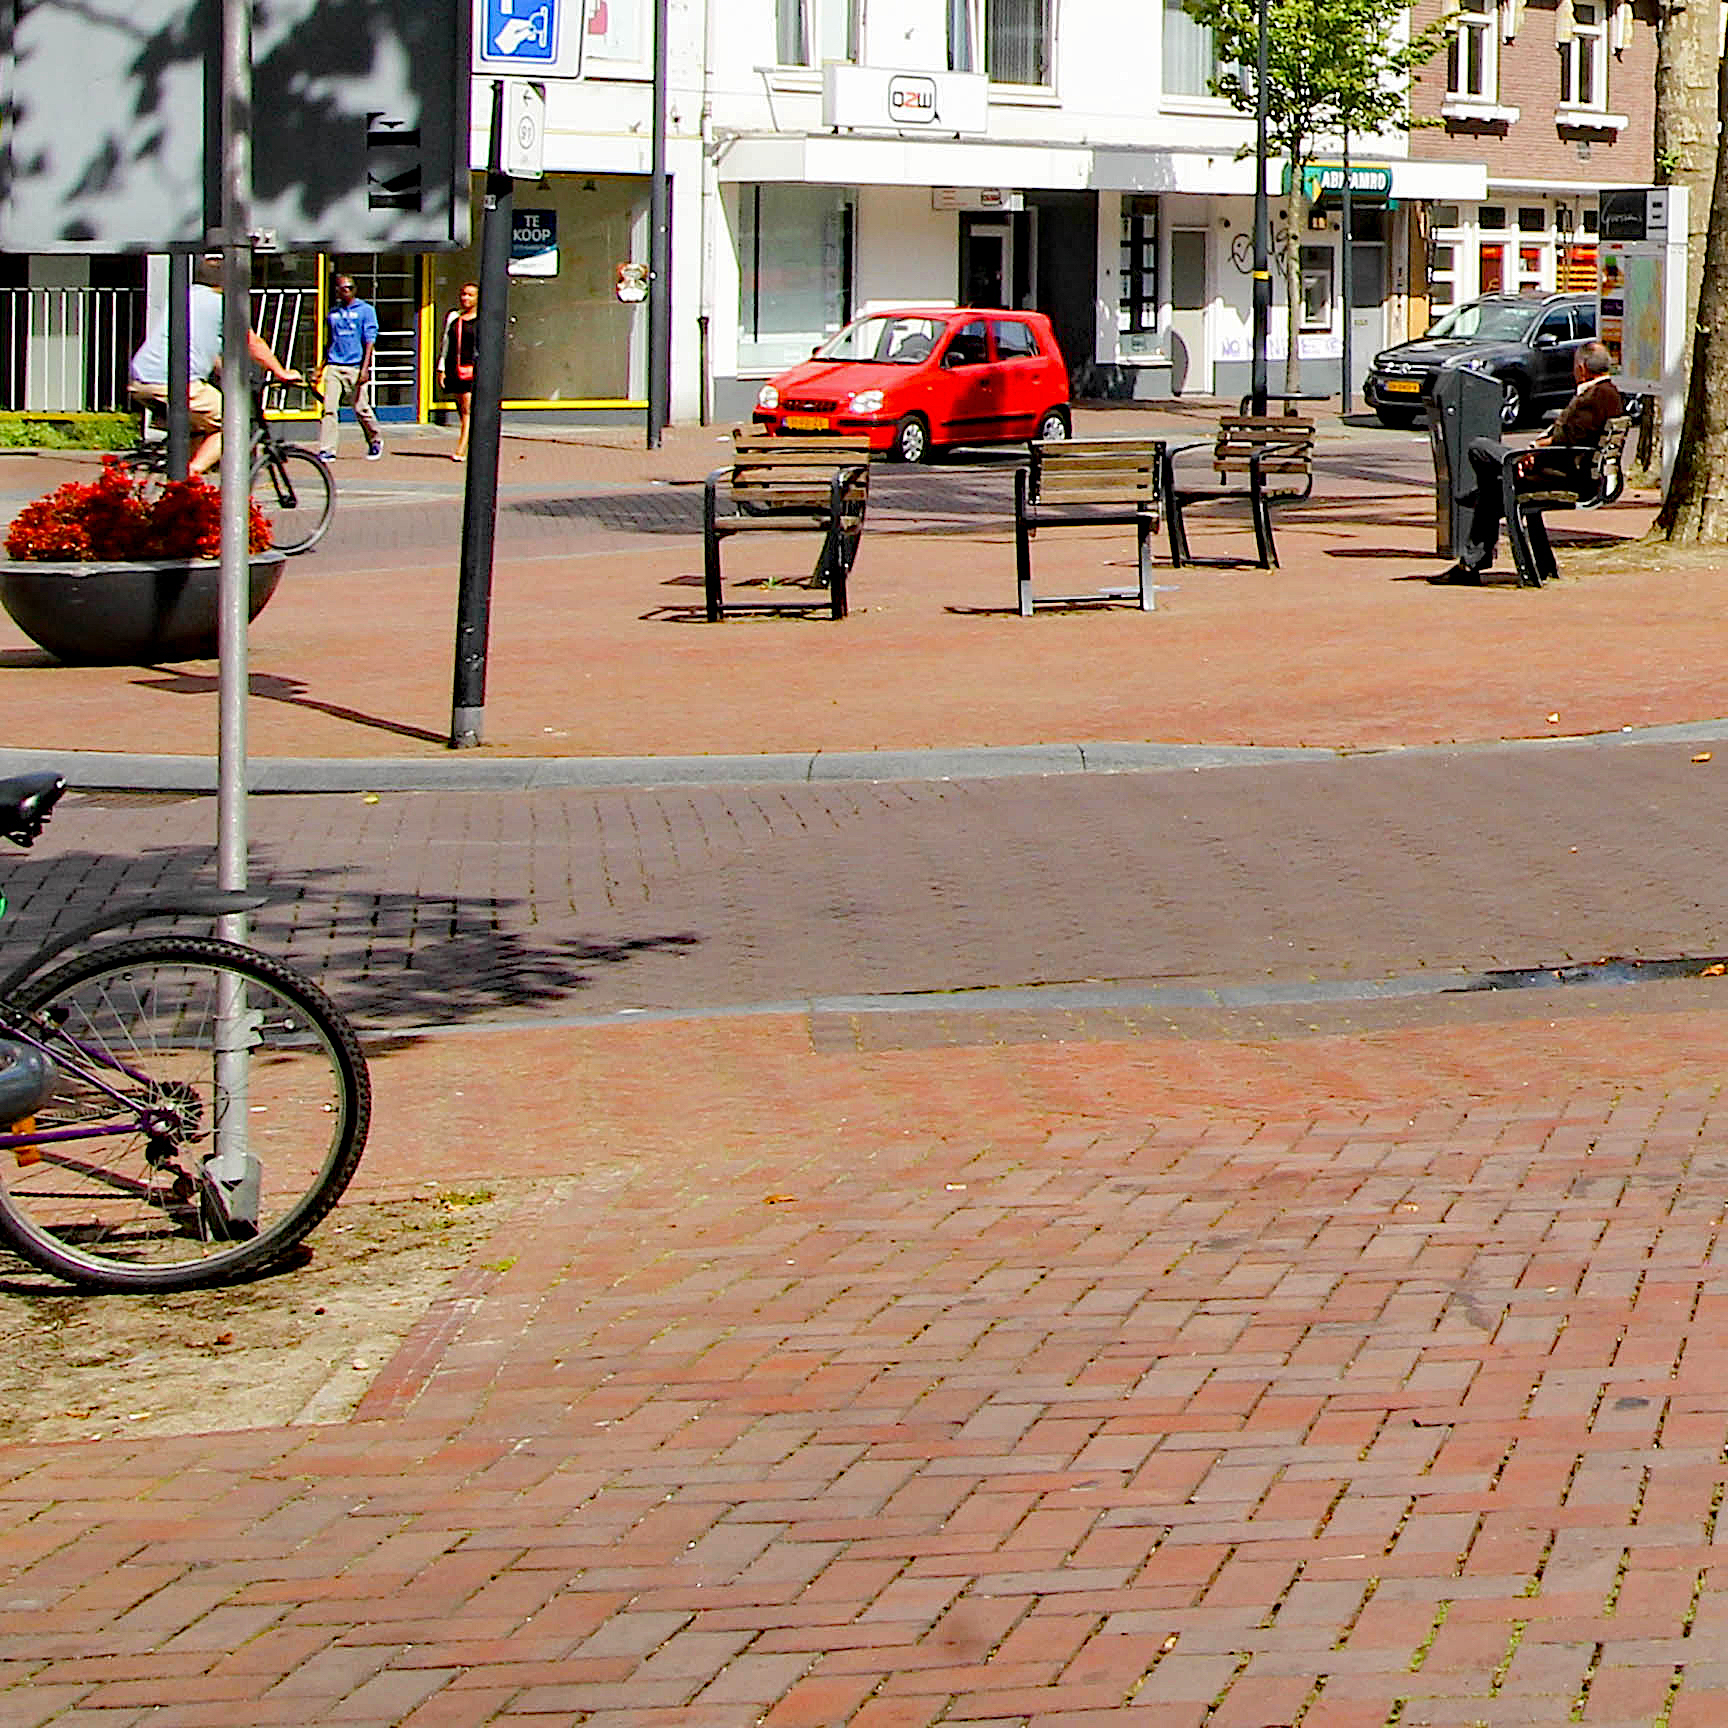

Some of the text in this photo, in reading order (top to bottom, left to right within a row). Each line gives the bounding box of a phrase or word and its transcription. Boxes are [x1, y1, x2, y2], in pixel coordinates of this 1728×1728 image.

[1349, 171, 1387, 190] AMRO
[523, 214, 541, 228] TE
[512, 228, 551, 242] KOOP
